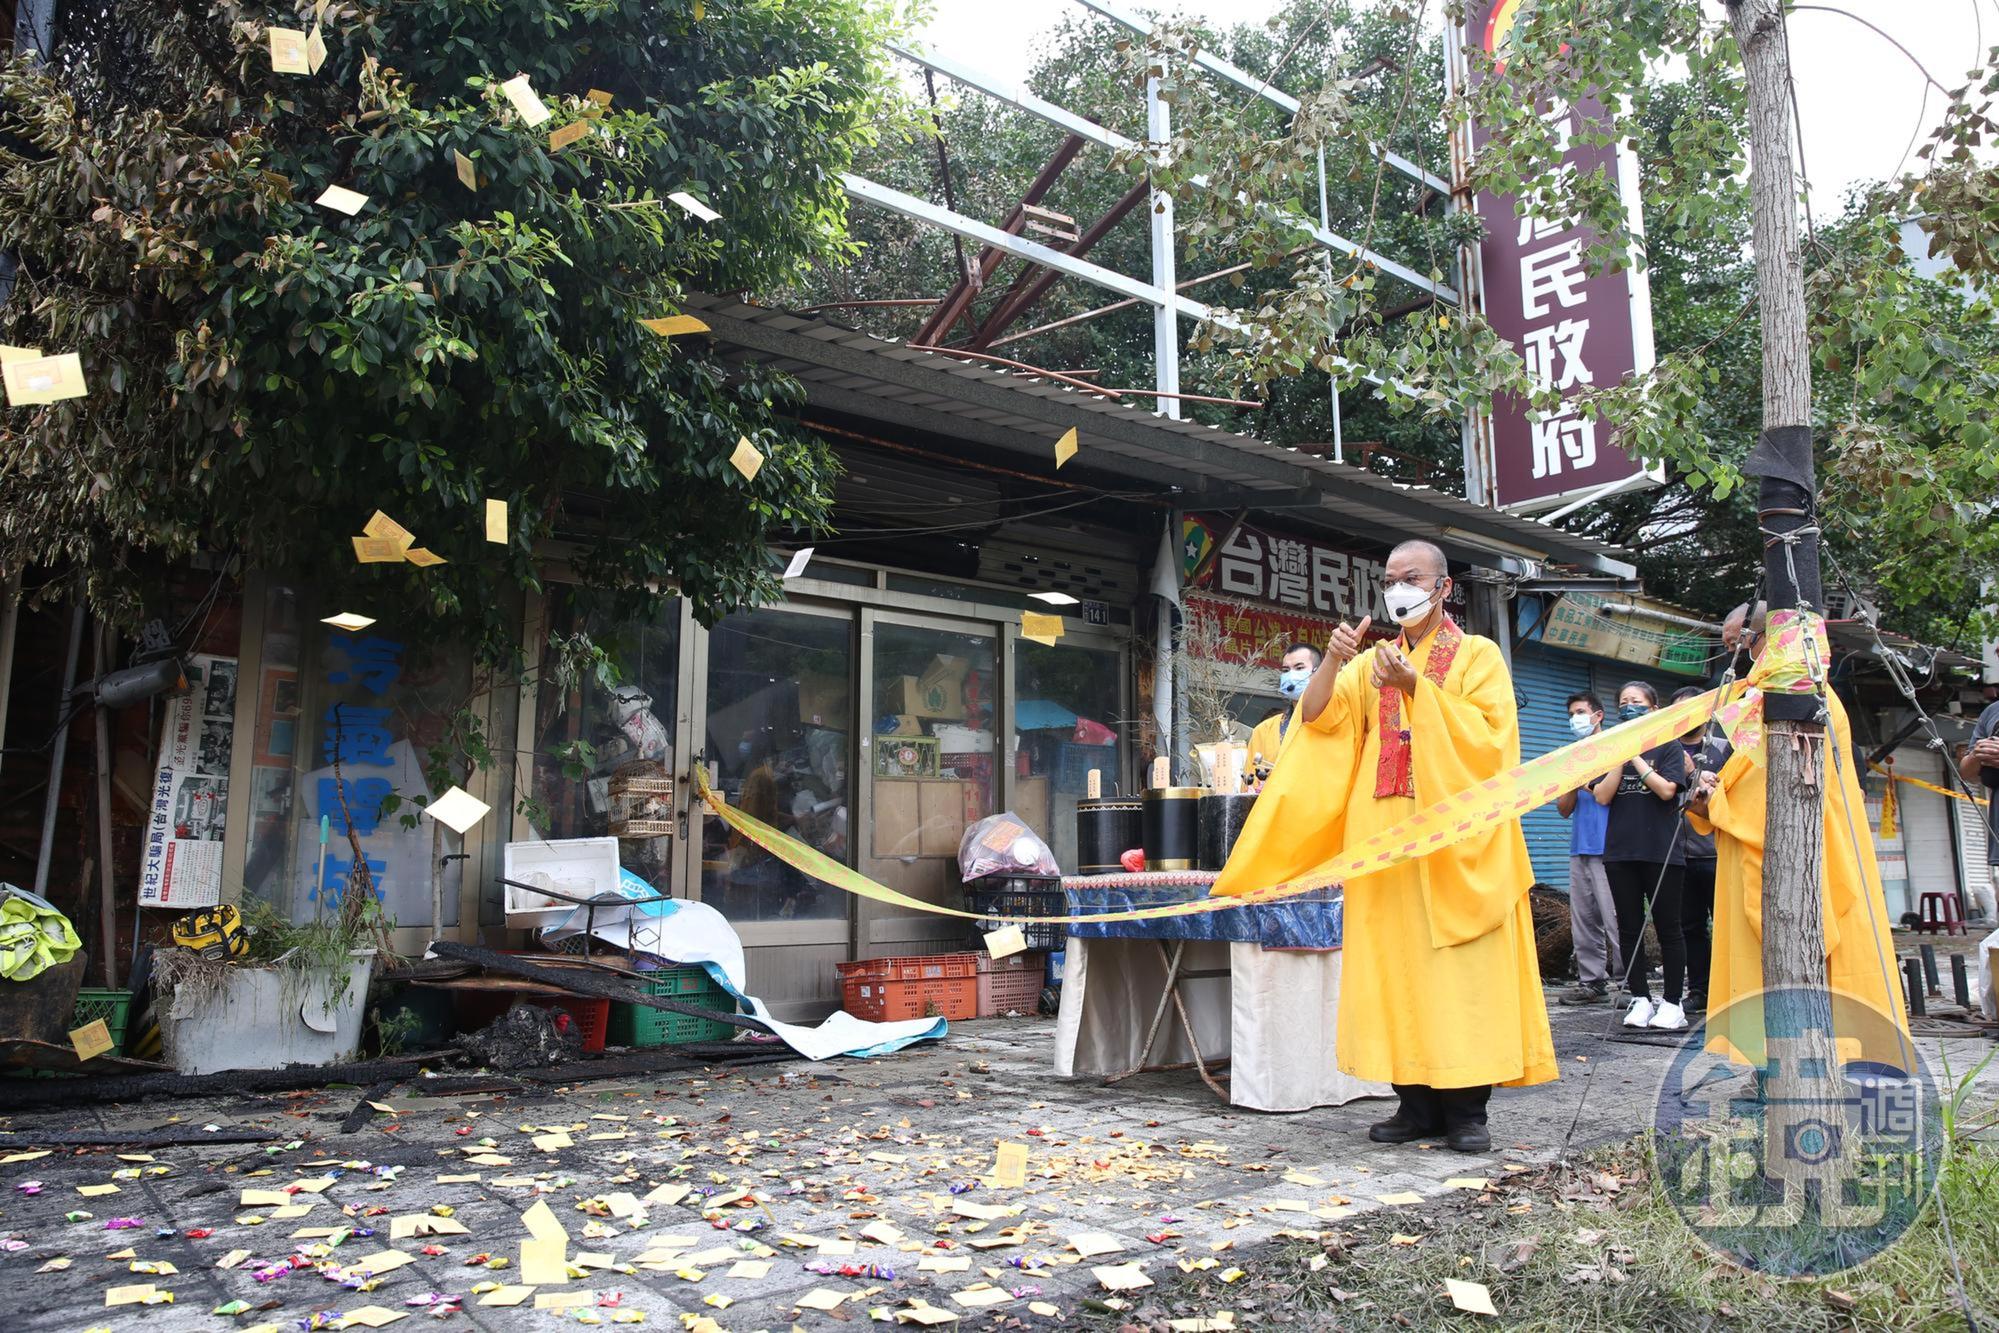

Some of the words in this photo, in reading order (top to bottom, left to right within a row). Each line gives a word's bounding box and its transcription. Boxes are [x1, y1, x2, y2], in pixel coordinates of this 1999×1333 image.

[1221, 527, 1400, 625] 台灣民政
[1089, 608, 1106, 624] 141
